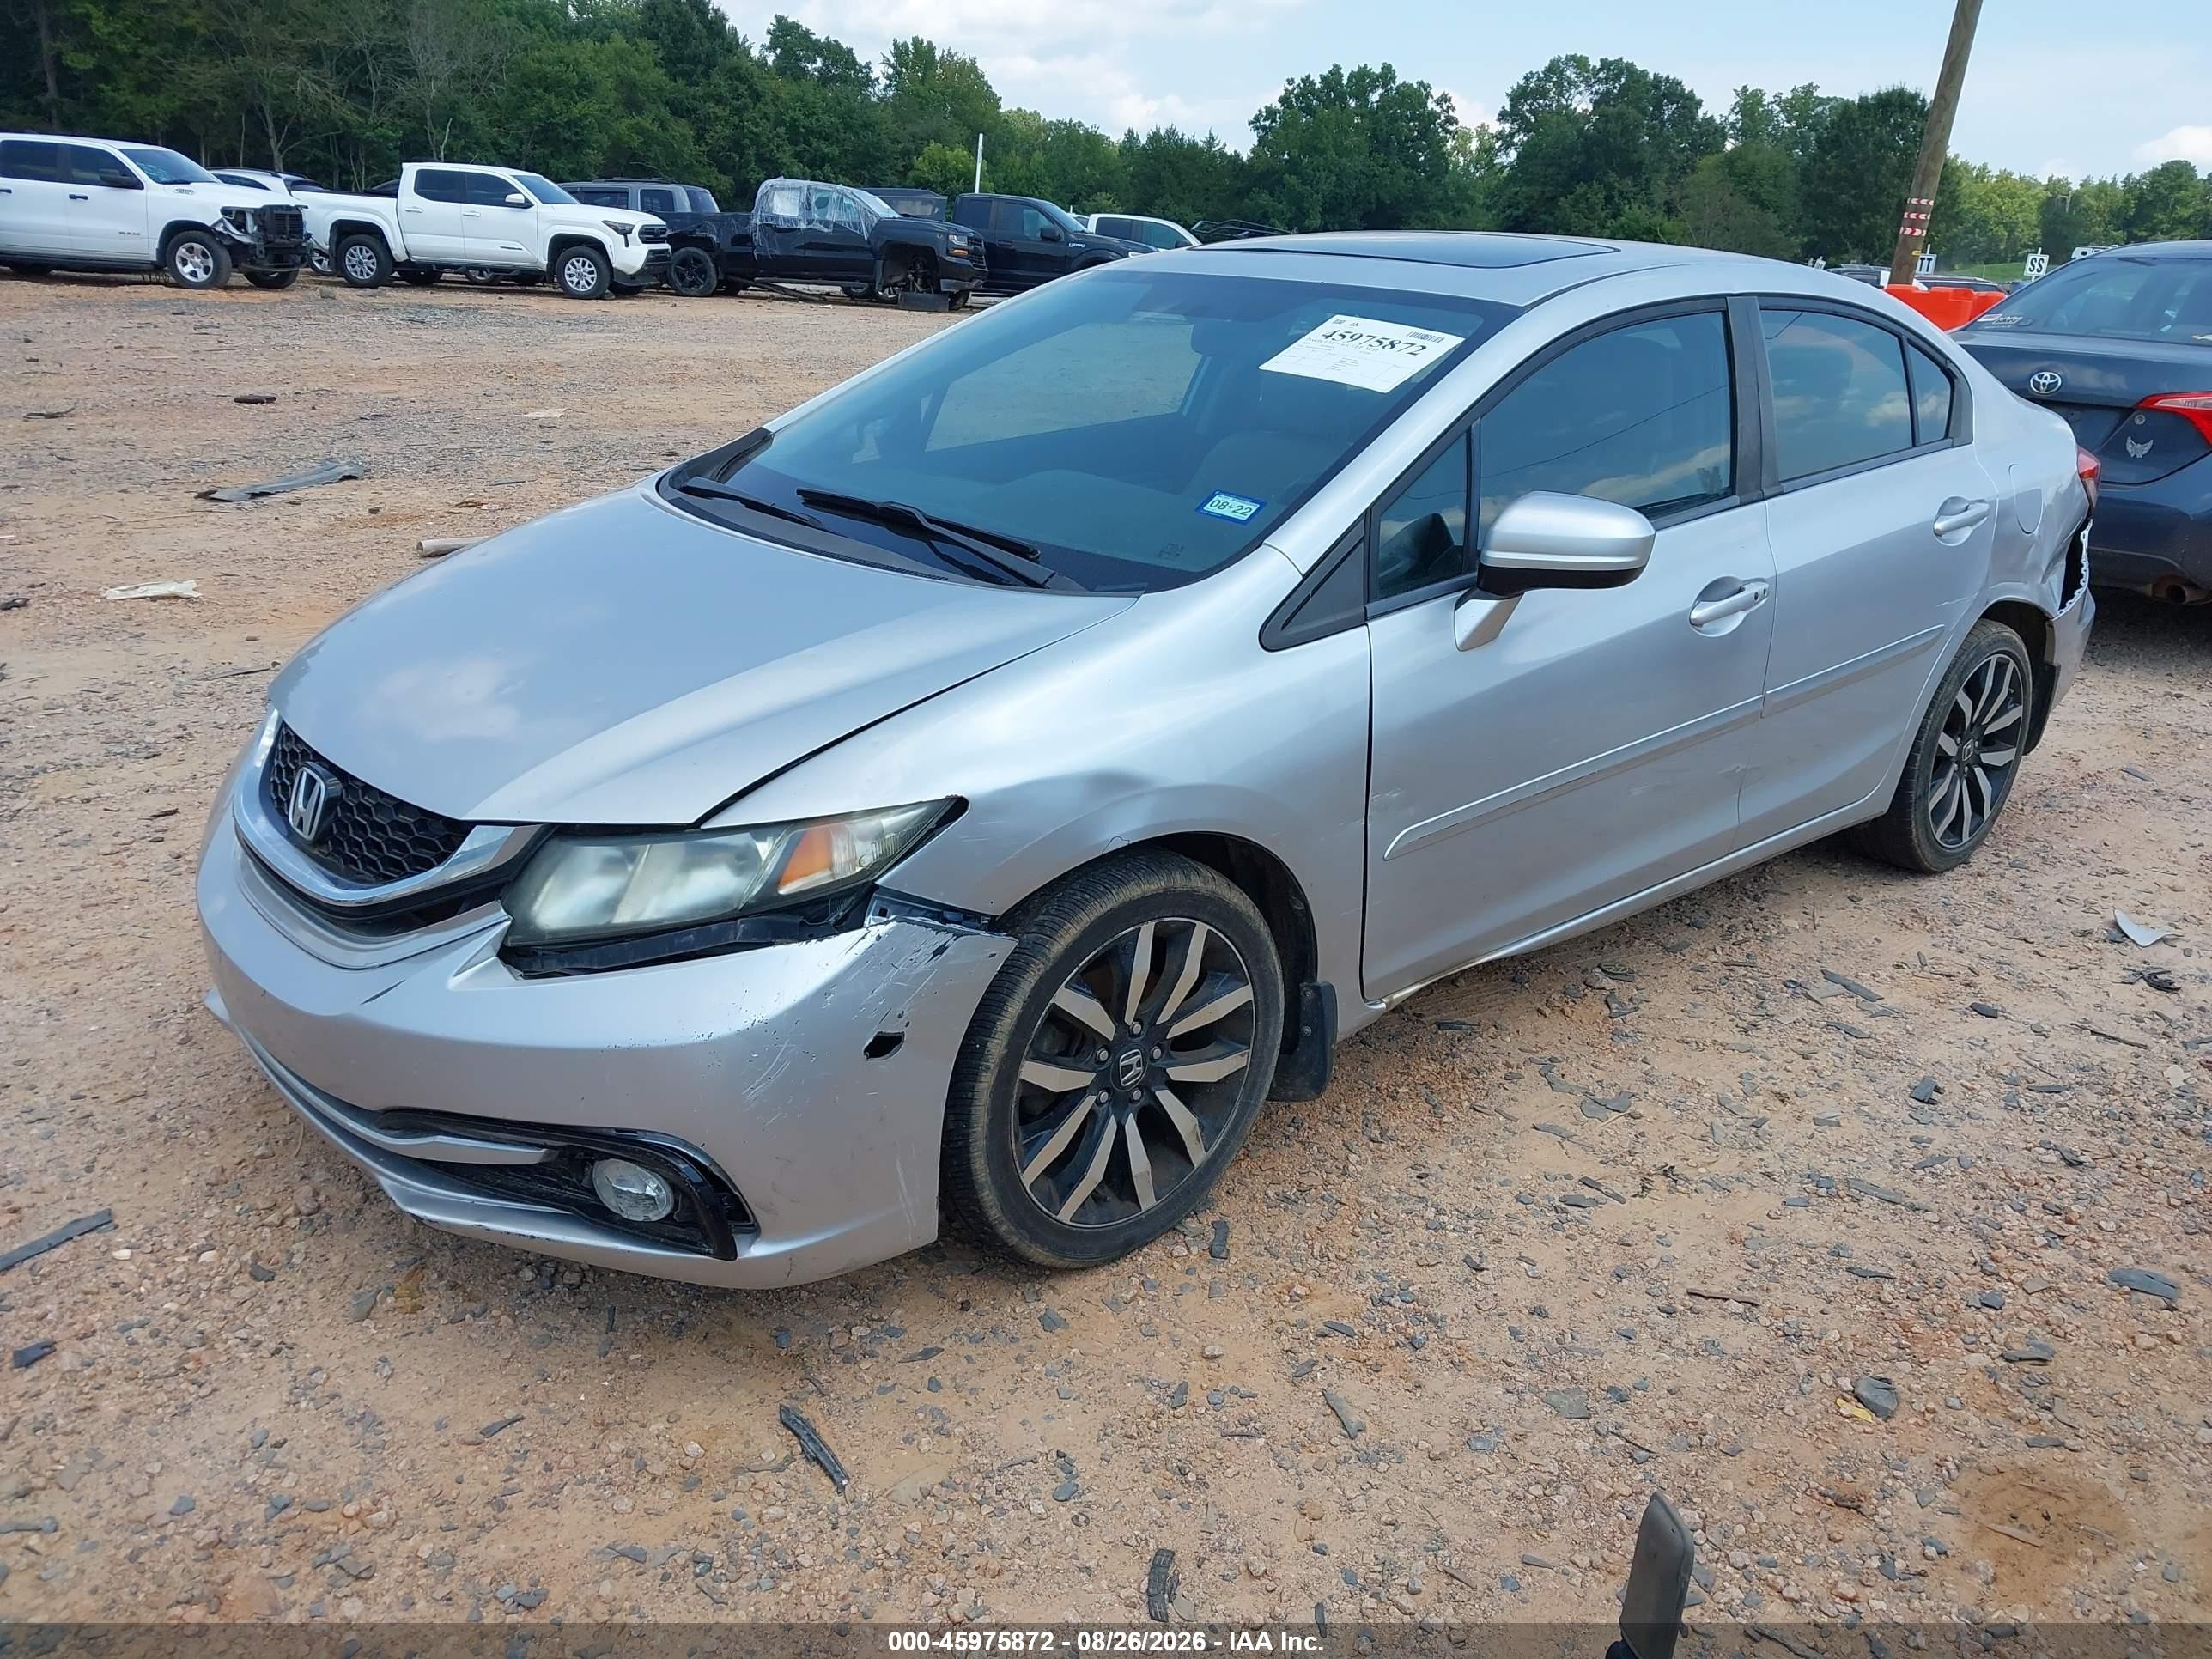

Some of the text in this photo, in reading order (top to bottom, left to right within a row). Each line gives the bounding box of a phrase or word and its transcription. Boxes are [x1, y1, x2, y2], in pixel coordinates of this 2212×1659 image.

[1919, 257, 1933, 272] TT
[2028, 257, 2045, 273] SS
[1321, 329, 1427, 356] 45975872
